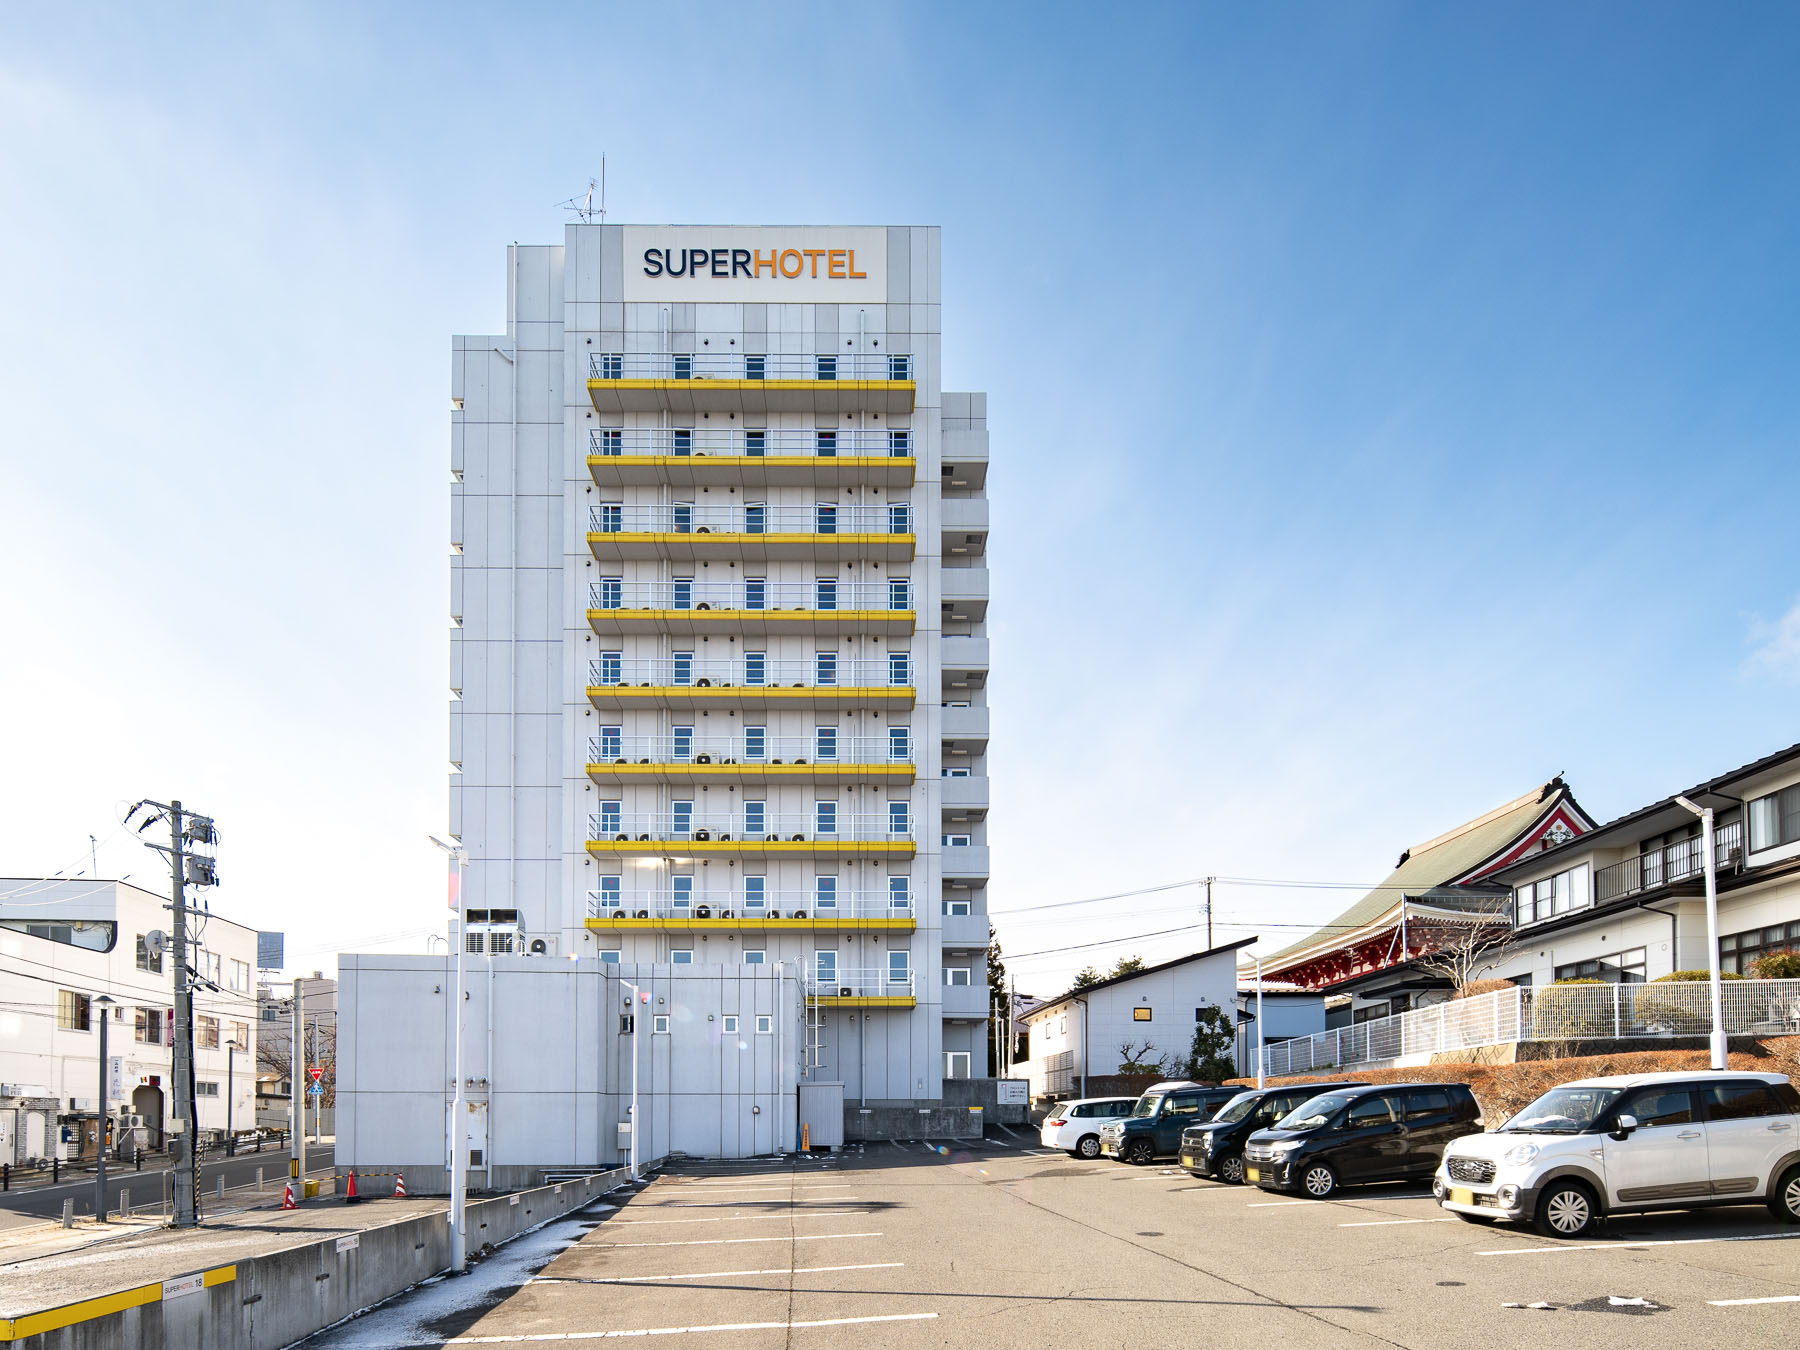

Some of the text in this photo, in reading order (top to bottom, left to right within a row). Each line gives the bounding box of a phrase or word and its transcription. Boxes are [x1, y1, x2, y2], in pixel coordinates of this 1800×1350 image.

[643, 248, 867, 279] SUPERHOTEL
[164, 1278, 203, 1294] SUPERHOTEL 18
